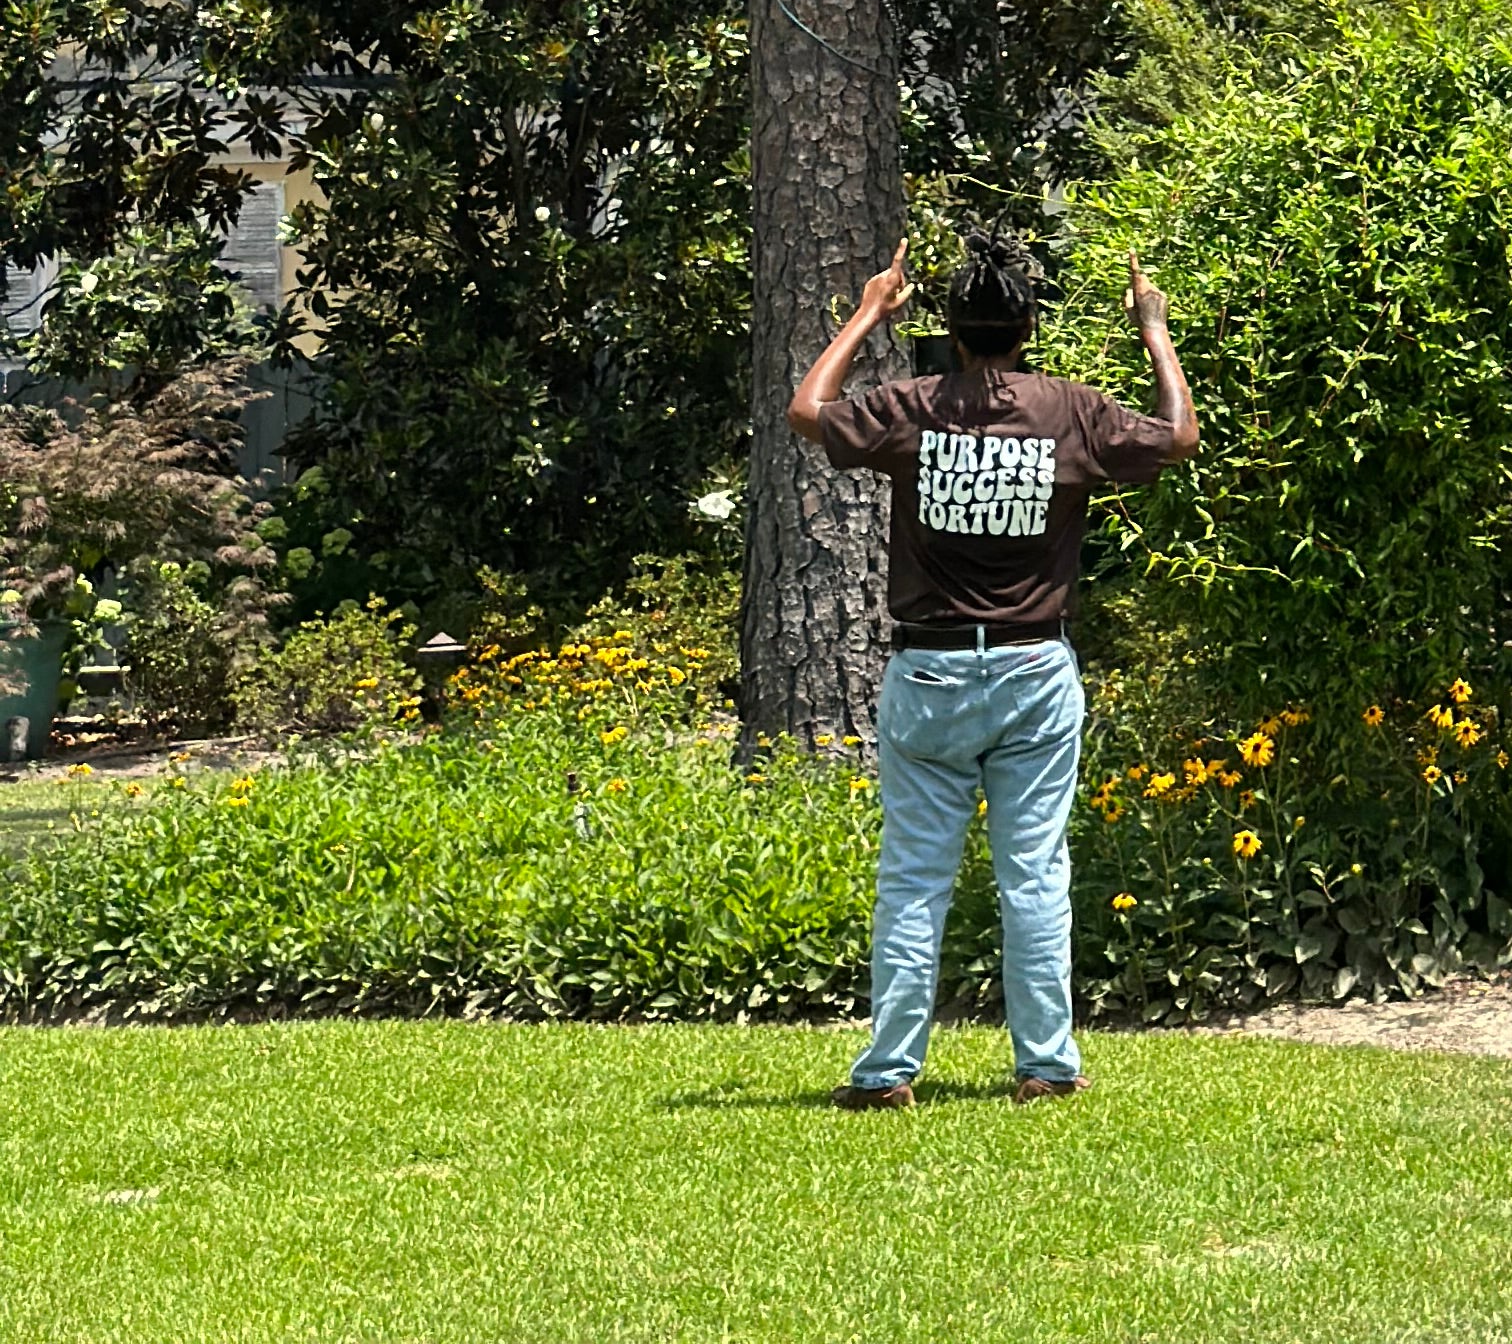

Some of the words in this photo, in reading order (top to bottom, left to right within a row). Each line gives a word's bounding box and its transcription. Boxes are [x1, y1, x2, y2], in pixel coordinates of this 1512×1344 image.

[918, 430, 1056, 472] PURPOSE
[917, 465, 1055, 504] SUCCESS
[918, 493, 1049, 537] FORTUNE
